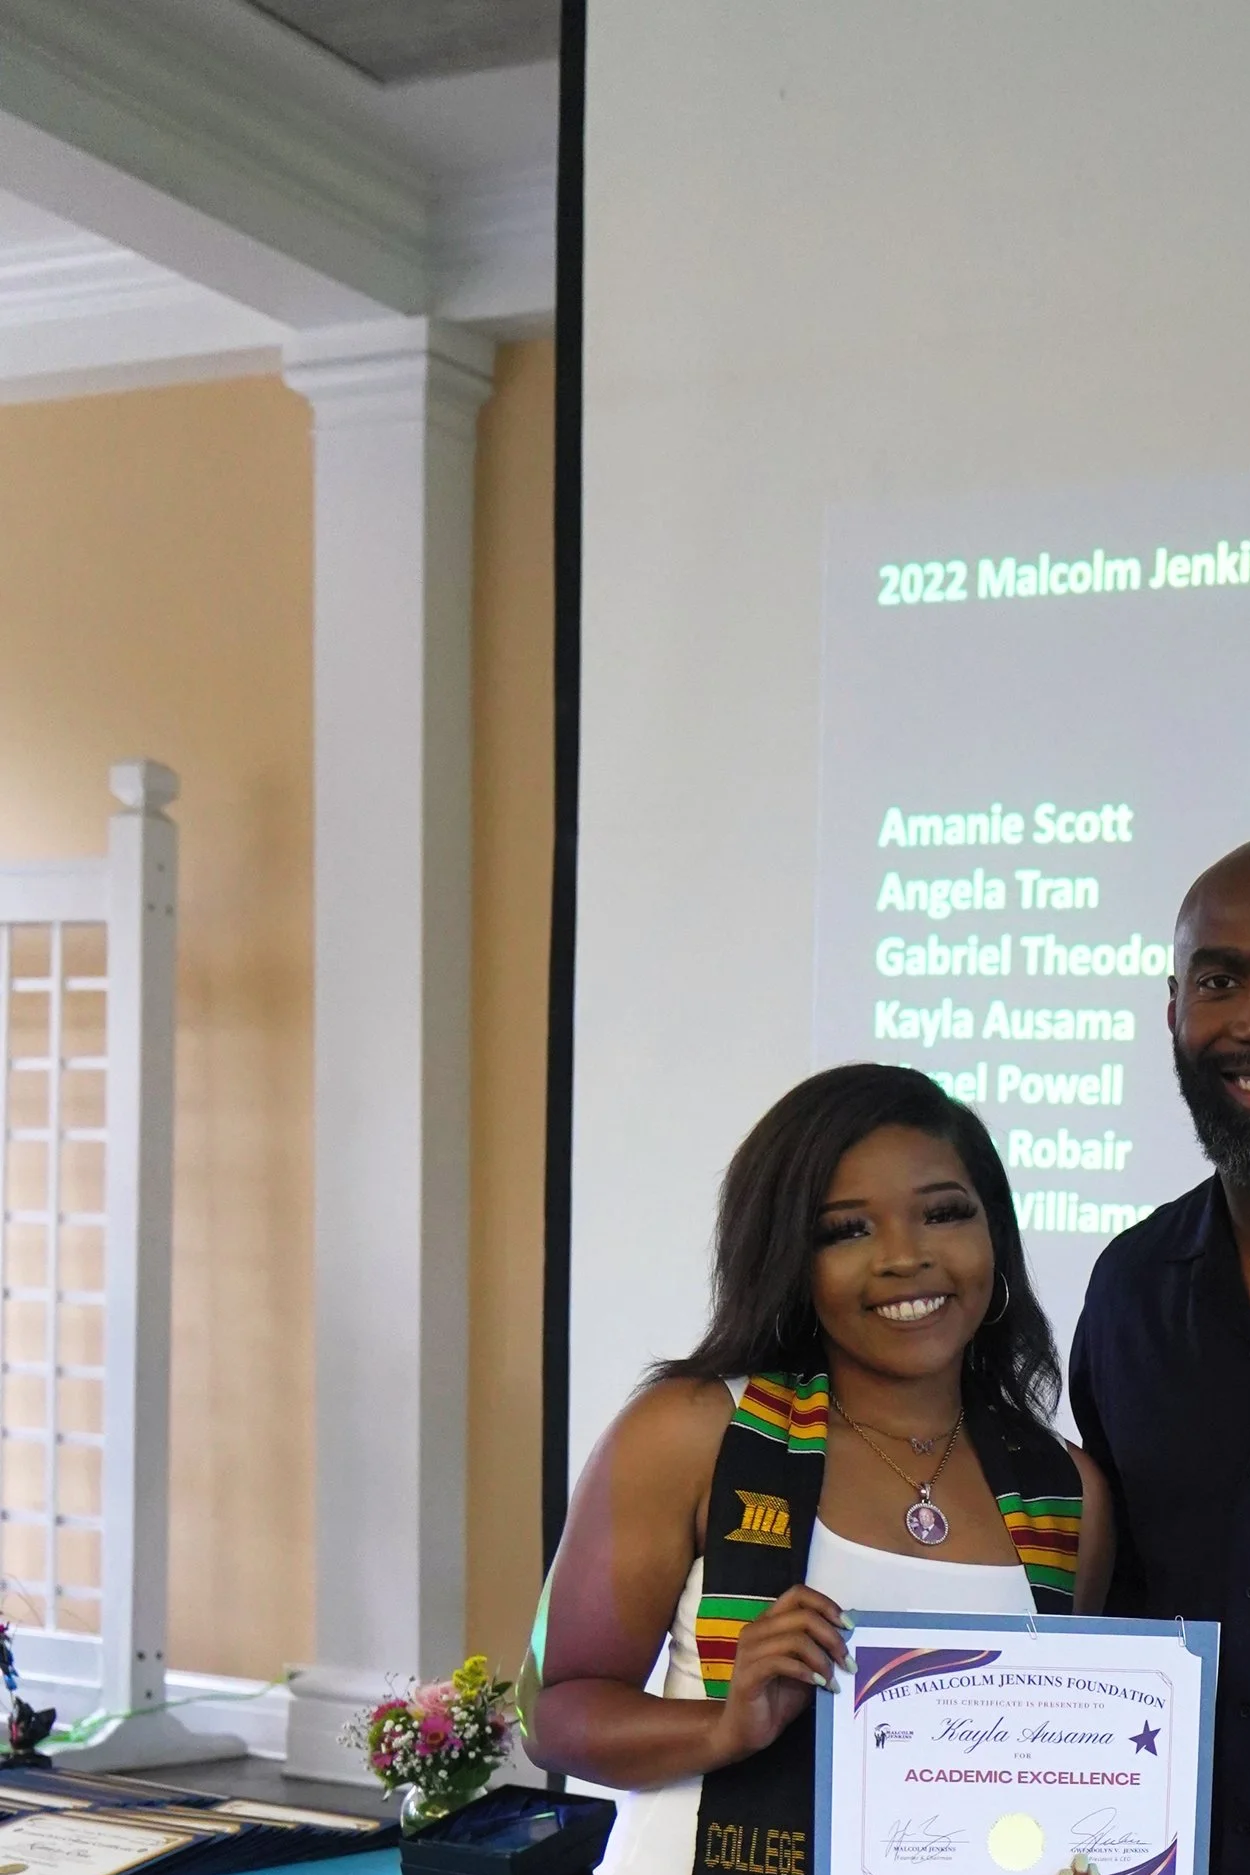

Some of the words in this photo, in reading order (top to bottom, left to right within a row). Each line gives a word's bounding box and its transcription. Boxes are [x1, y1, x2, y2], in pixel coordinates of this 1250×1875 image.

[878, 560, 968, 605] 2022
[976, 548, 1141, 599] Malcolm
[878, 803, 1025, 848] Amanie
[1033, 803, 1134, 843] Scott
[876, 868, 1006, 920] Angela
[1015, 869, 1099, 909] Tran
[876, 934, 1012, 977] Gabriel
[874, 997, 974, 1048] Kayla
[983, 1001, 1136, 1042] Ausama
[997, 1062, 1124, 1106] Powell
[1008, 1127, 1133, 1172] Robair
[878, 1685, 911, 1702] THE
[914, 1674, 994, 1694] MALCOLM
[998, 1673, 1063, 1688] JENKINS
[1066, 1676, 1167, 1709] FOUNDATION
[961, 1699, 1024, 1708] CERTIFICATE
[1026, 1700, 1036, 1708] IS
[1038, 1700, 1091, 1709] PRESENTED
[931, 1716, 1010, 1754] Kayla
[1017, 1720, 1115, 1745] Ausama
[904, 1768, 1013, 1784] ACADEMIC
[1017, 1770, 1141, 1786] EXCELLENCE
